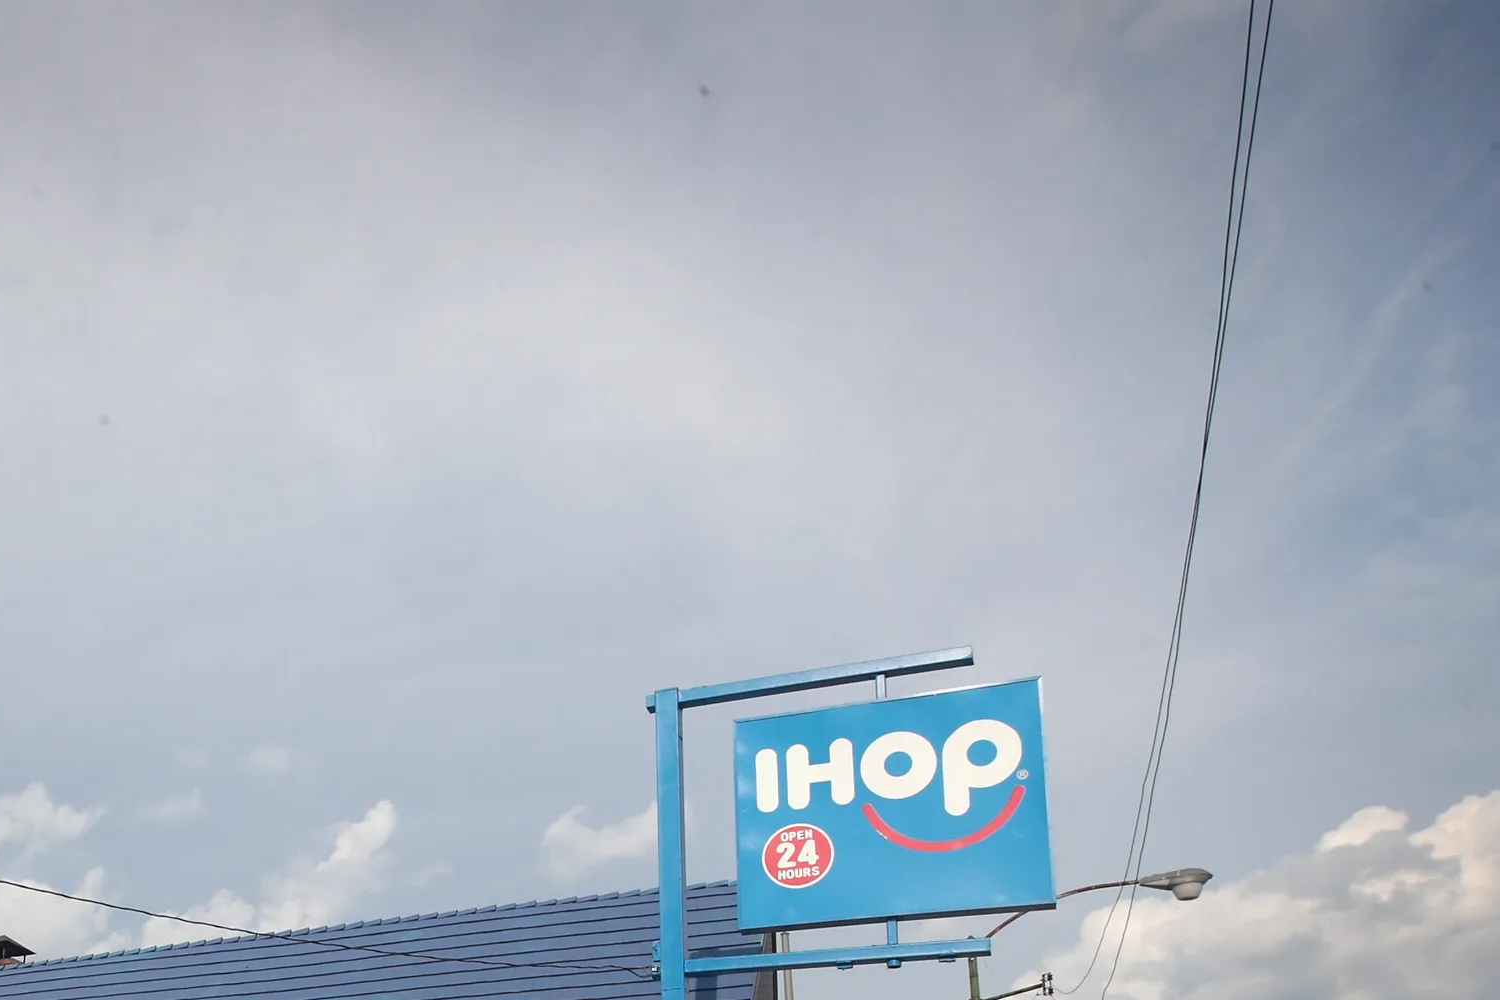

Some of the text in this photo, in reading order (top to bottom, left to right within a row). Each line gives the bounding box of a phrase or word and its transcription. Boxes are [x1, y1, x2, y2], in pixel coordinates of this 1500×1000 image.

[755, 719, 1022, 816] IHOP
[780, 829, 813, 842] OPEN
[776, 839, 819, 868] 24
[777, 866, 820, 880] HOURS
